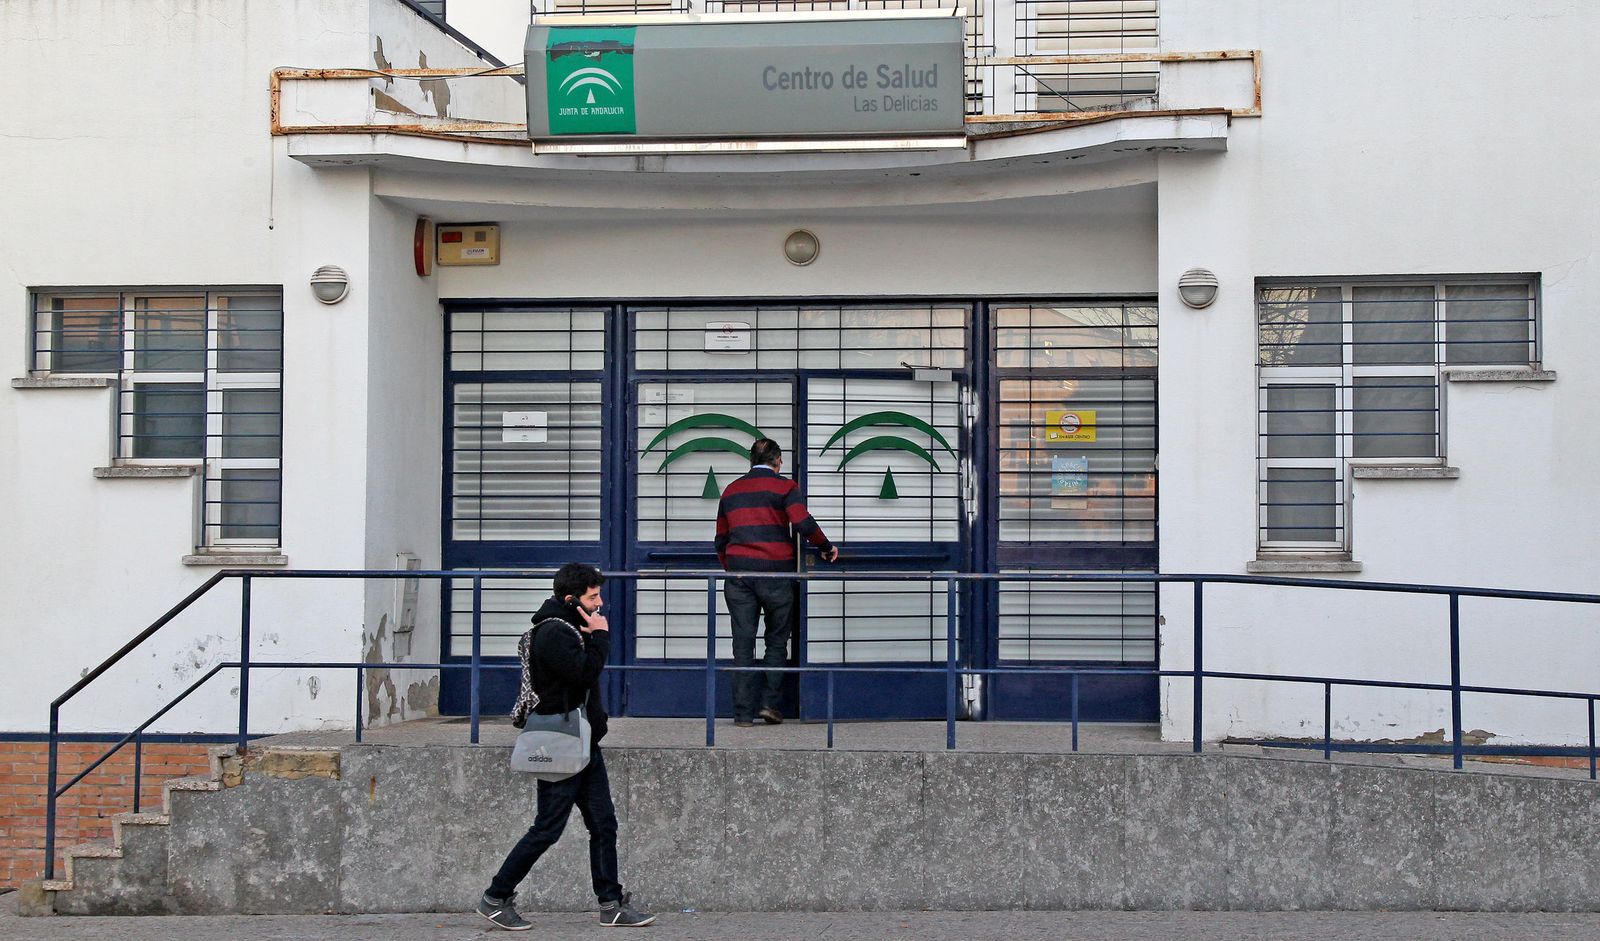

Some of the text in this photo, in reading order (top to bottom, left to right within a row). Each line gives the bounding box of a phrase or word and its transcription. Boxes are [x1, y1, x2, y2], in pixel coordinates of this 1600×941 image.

[762, 63, 938, 91] Centro de Salud
[559, 107, 578, 115] JUNTA
[580, 107, 589, 115] DE
[853, 94, 938, 112] Las Delicias
